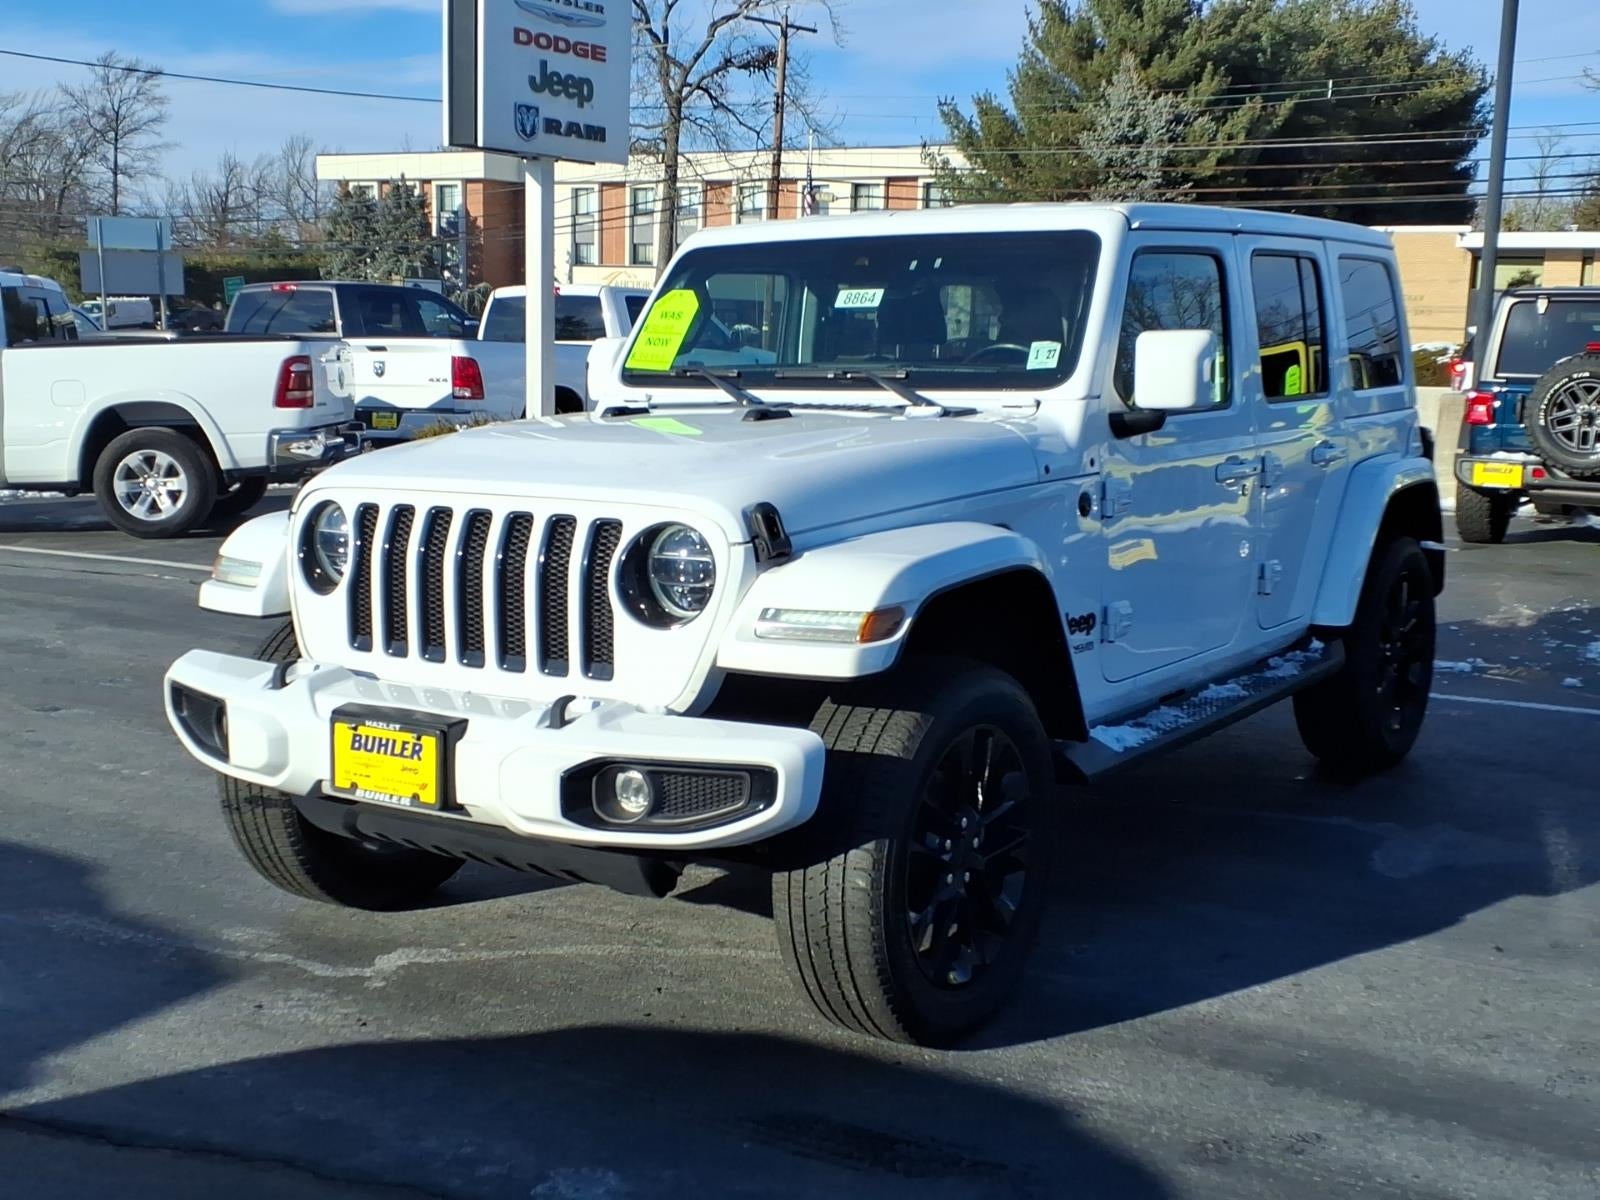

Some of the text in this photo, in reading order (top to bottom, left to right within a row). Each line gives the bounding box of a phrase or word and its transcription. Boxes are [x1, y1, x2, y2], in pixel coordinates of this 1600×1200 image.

[514, 27, 606, 62] DODGE
[528, 59, 594, 109] Jeep
[544, 118, 606, 143] RAM
[843, 291, 877, 305] 8864
[1046, 349, 1057, 360] 27
[1065, 612, 1097, 636] Jeep
[351, 734, 423, 761] BUHLER
[355, 789, 411, 806] BUHLER
